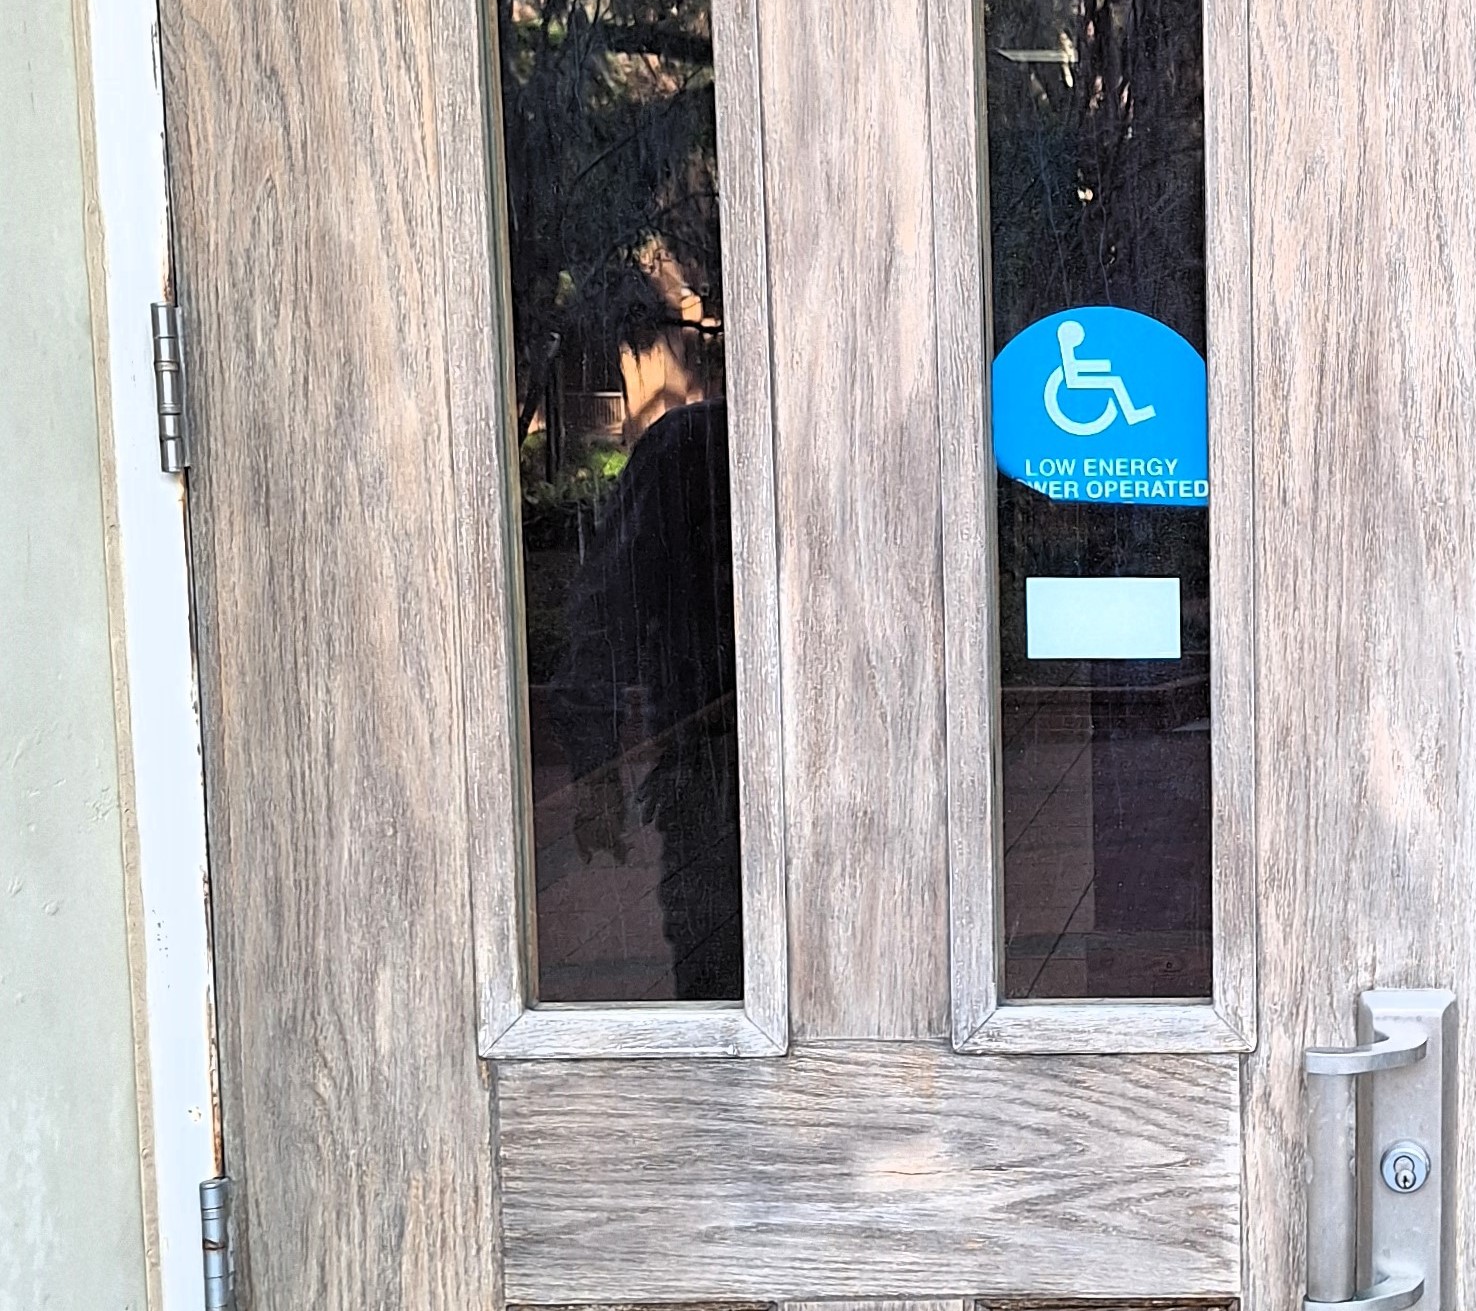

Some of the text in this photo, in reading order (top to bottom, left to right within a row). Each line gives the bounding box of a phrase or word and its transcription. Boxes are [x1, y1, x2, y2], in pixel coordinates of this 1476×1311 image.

[1025, 457, 1179, 477] LOW ENERGY
[1086, 479, 1209, 499] OPERATED
